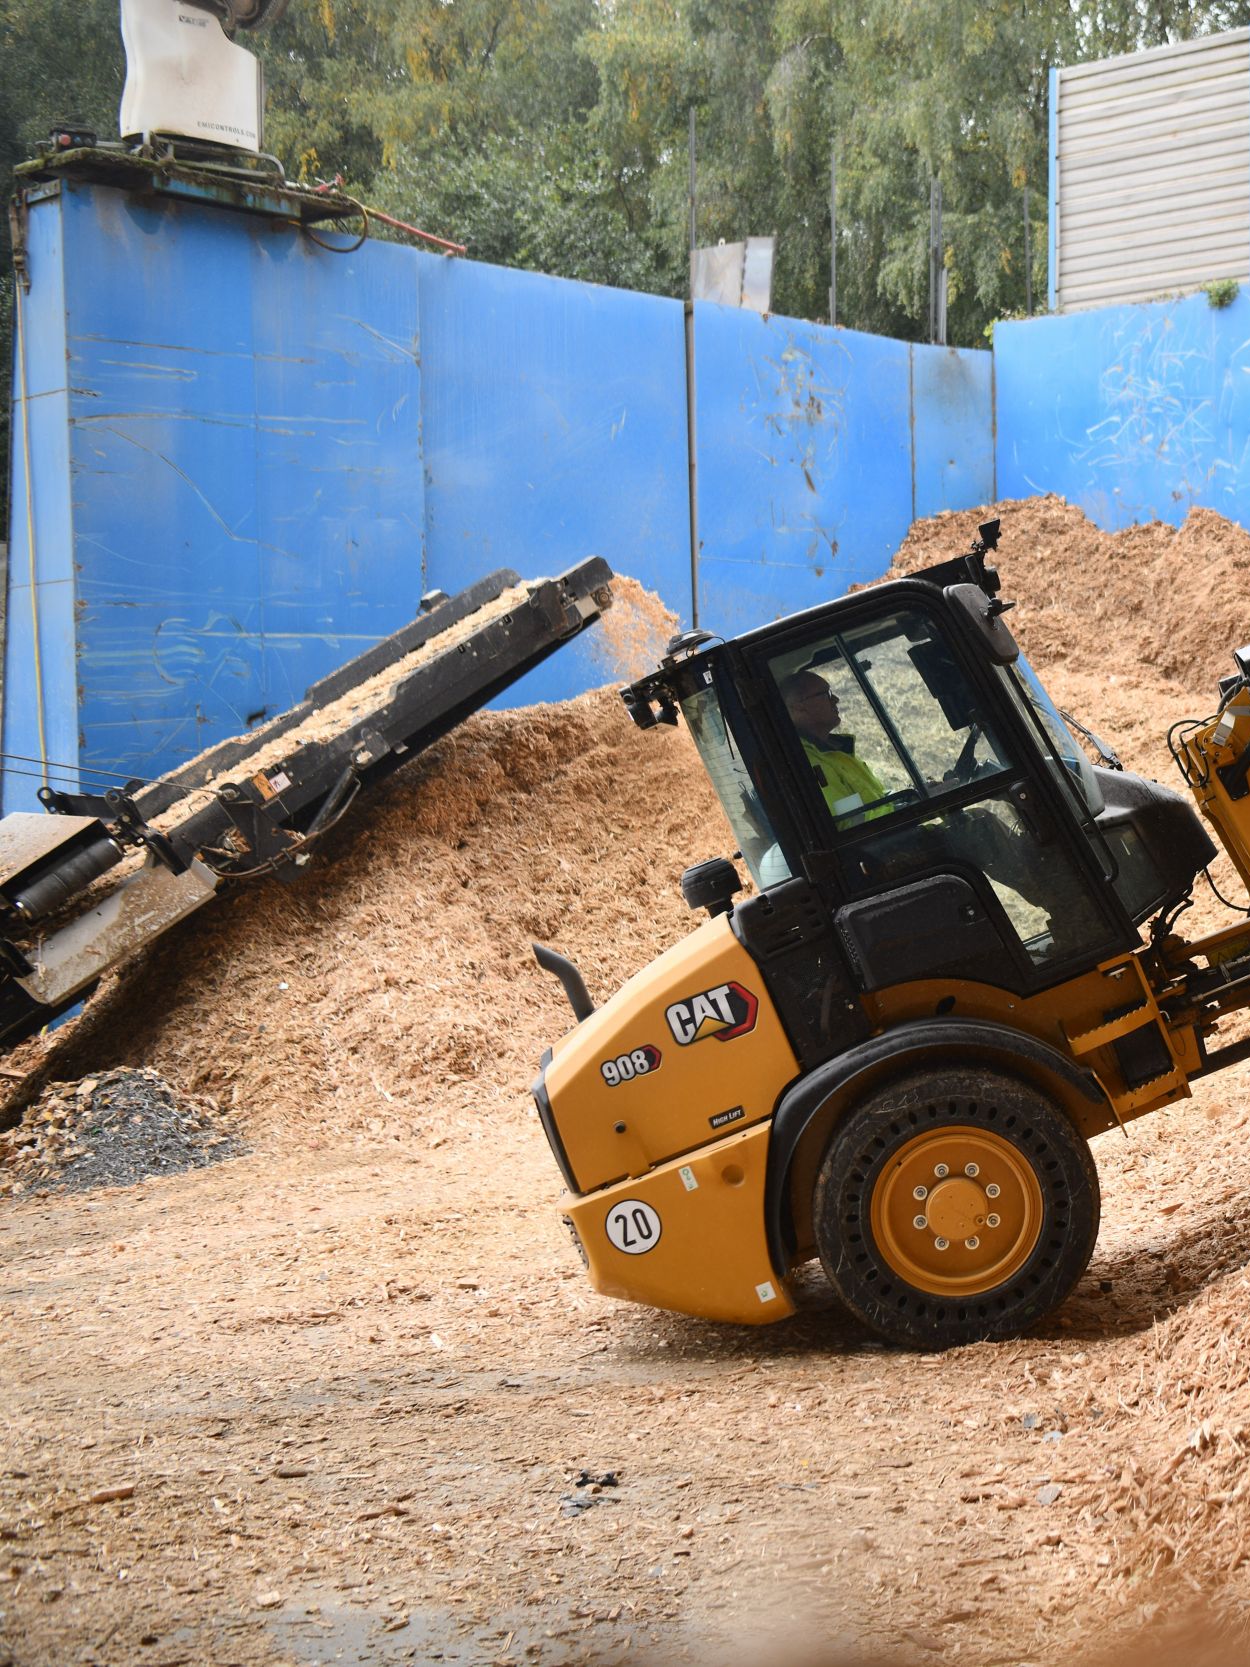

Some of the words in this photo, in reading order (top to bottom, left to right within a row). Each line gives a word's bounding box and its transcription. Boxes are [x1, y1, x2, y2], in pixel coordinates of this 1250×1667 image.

[667, 985, 736, 1044] CAT
[602, 1050, 650, 1085] 908
[615, 1208, 652, 1247] 20
